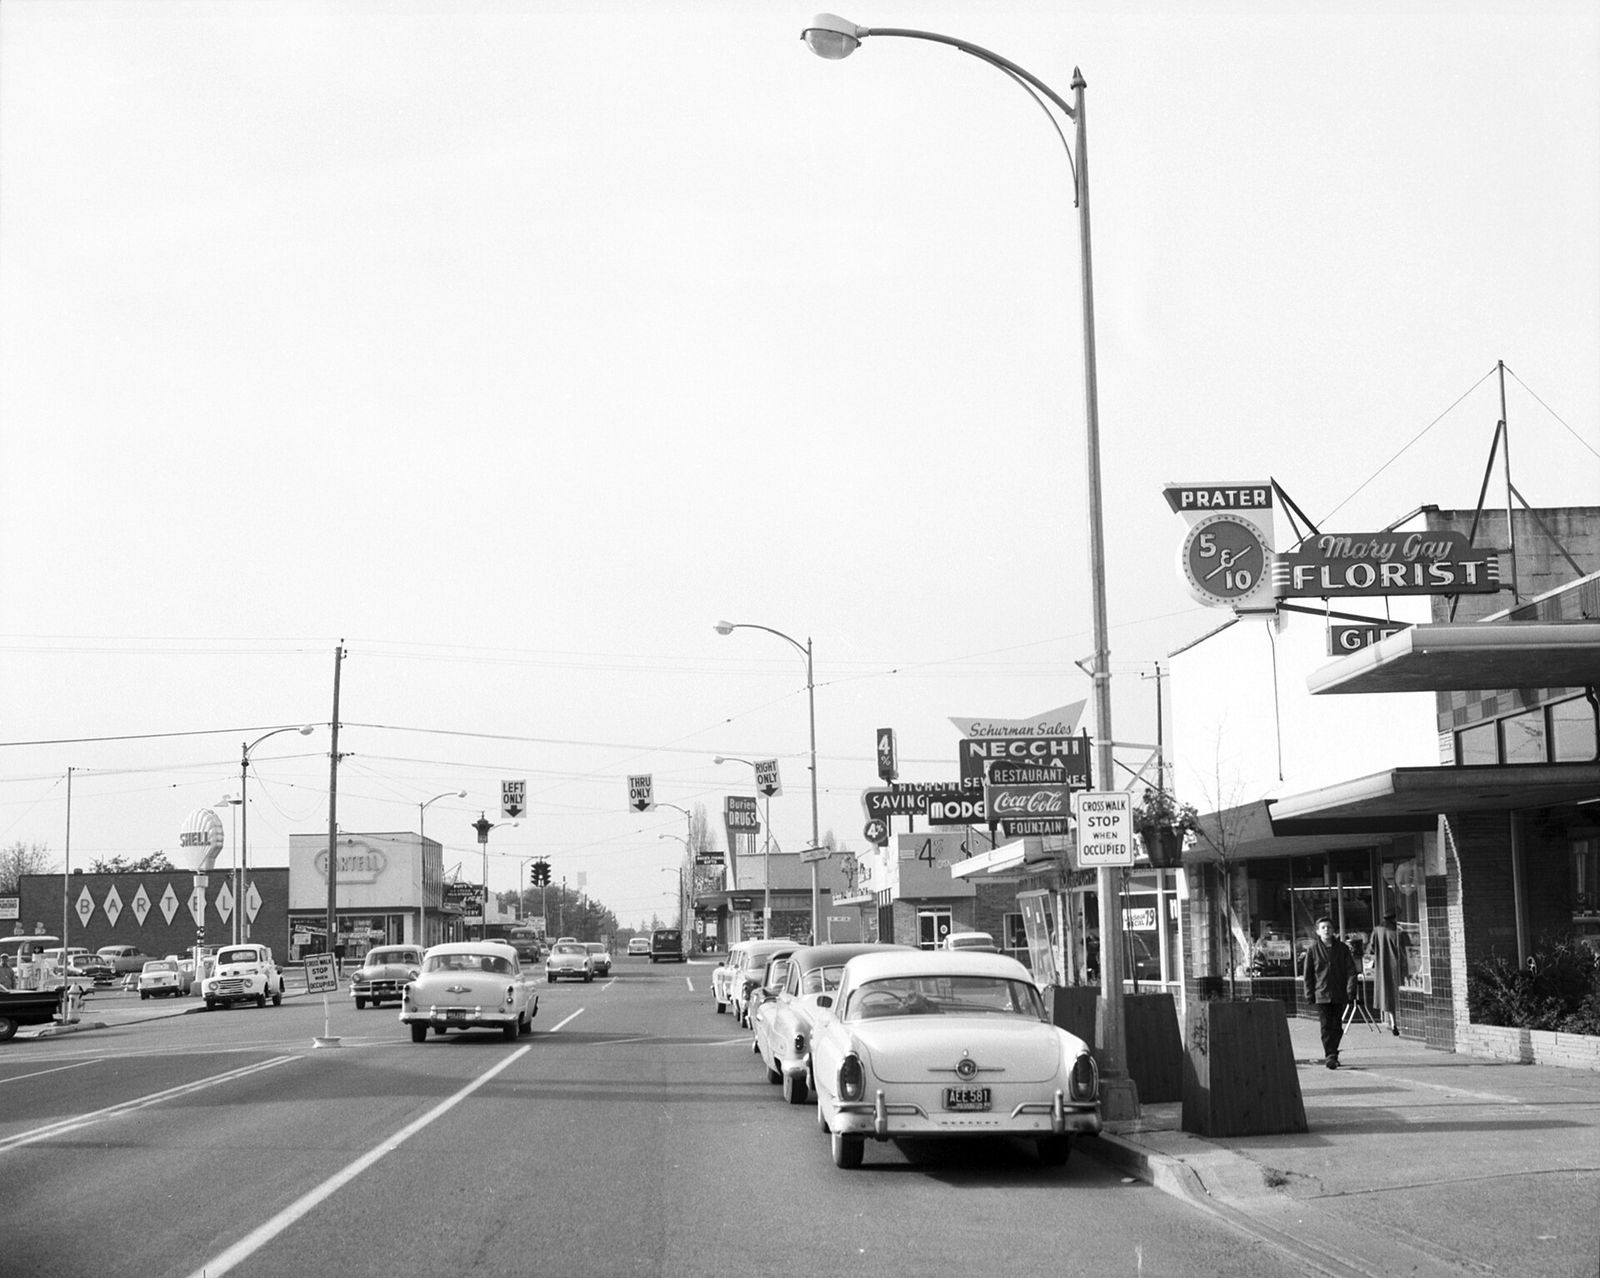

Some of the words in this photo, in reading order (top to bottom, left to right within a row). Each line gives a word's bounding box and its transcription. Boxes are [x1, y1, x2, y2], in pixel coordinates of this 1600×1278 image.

[1181, 489, 1267, 507] PRATER
[1318, 535, 1396, 562] Mary
[1402, 534, 1453, 562] Gay
[1199, 533, 1217, 558] 5
[1225, 569, 1252, 590] 10
[1293, 562, 1485, 590] FLORIST
[969, 722, 1035, 737] Schurman
[1036, 721, 1072, 737] Sales
[969, 740, 1079, 757] NECCHI
[755, 761, 776, 774] RIGHT
[757, 772, 778, 785] ONLY
[994, 768, 1064, 782] RESTAURANT
[502, 782, 525, 793] LEFT
[630, 776, 651, 788] THRU
[503, 793, 525, 804] ONLY
[630, 787, 651, 799] ONLY
[729, 798, 756, 810] Burien
[872, 794, 925, 810] SAVING
[930, 800, 985, 819] MODE
[728, 811, 757, 826] DRUGS
[1087, 815, 1120, 827] STOP
[1010, 821, 1062, 834] FOUNTAIN
[179, 831, 211, 848] SHELL
[1093, 831, 1118, 839] WHEN
[1083, 844, 1126, 855] OCCUPIED
[312, 966, 328, 975] STOP
[970, 1089, 988, 1102] 581
